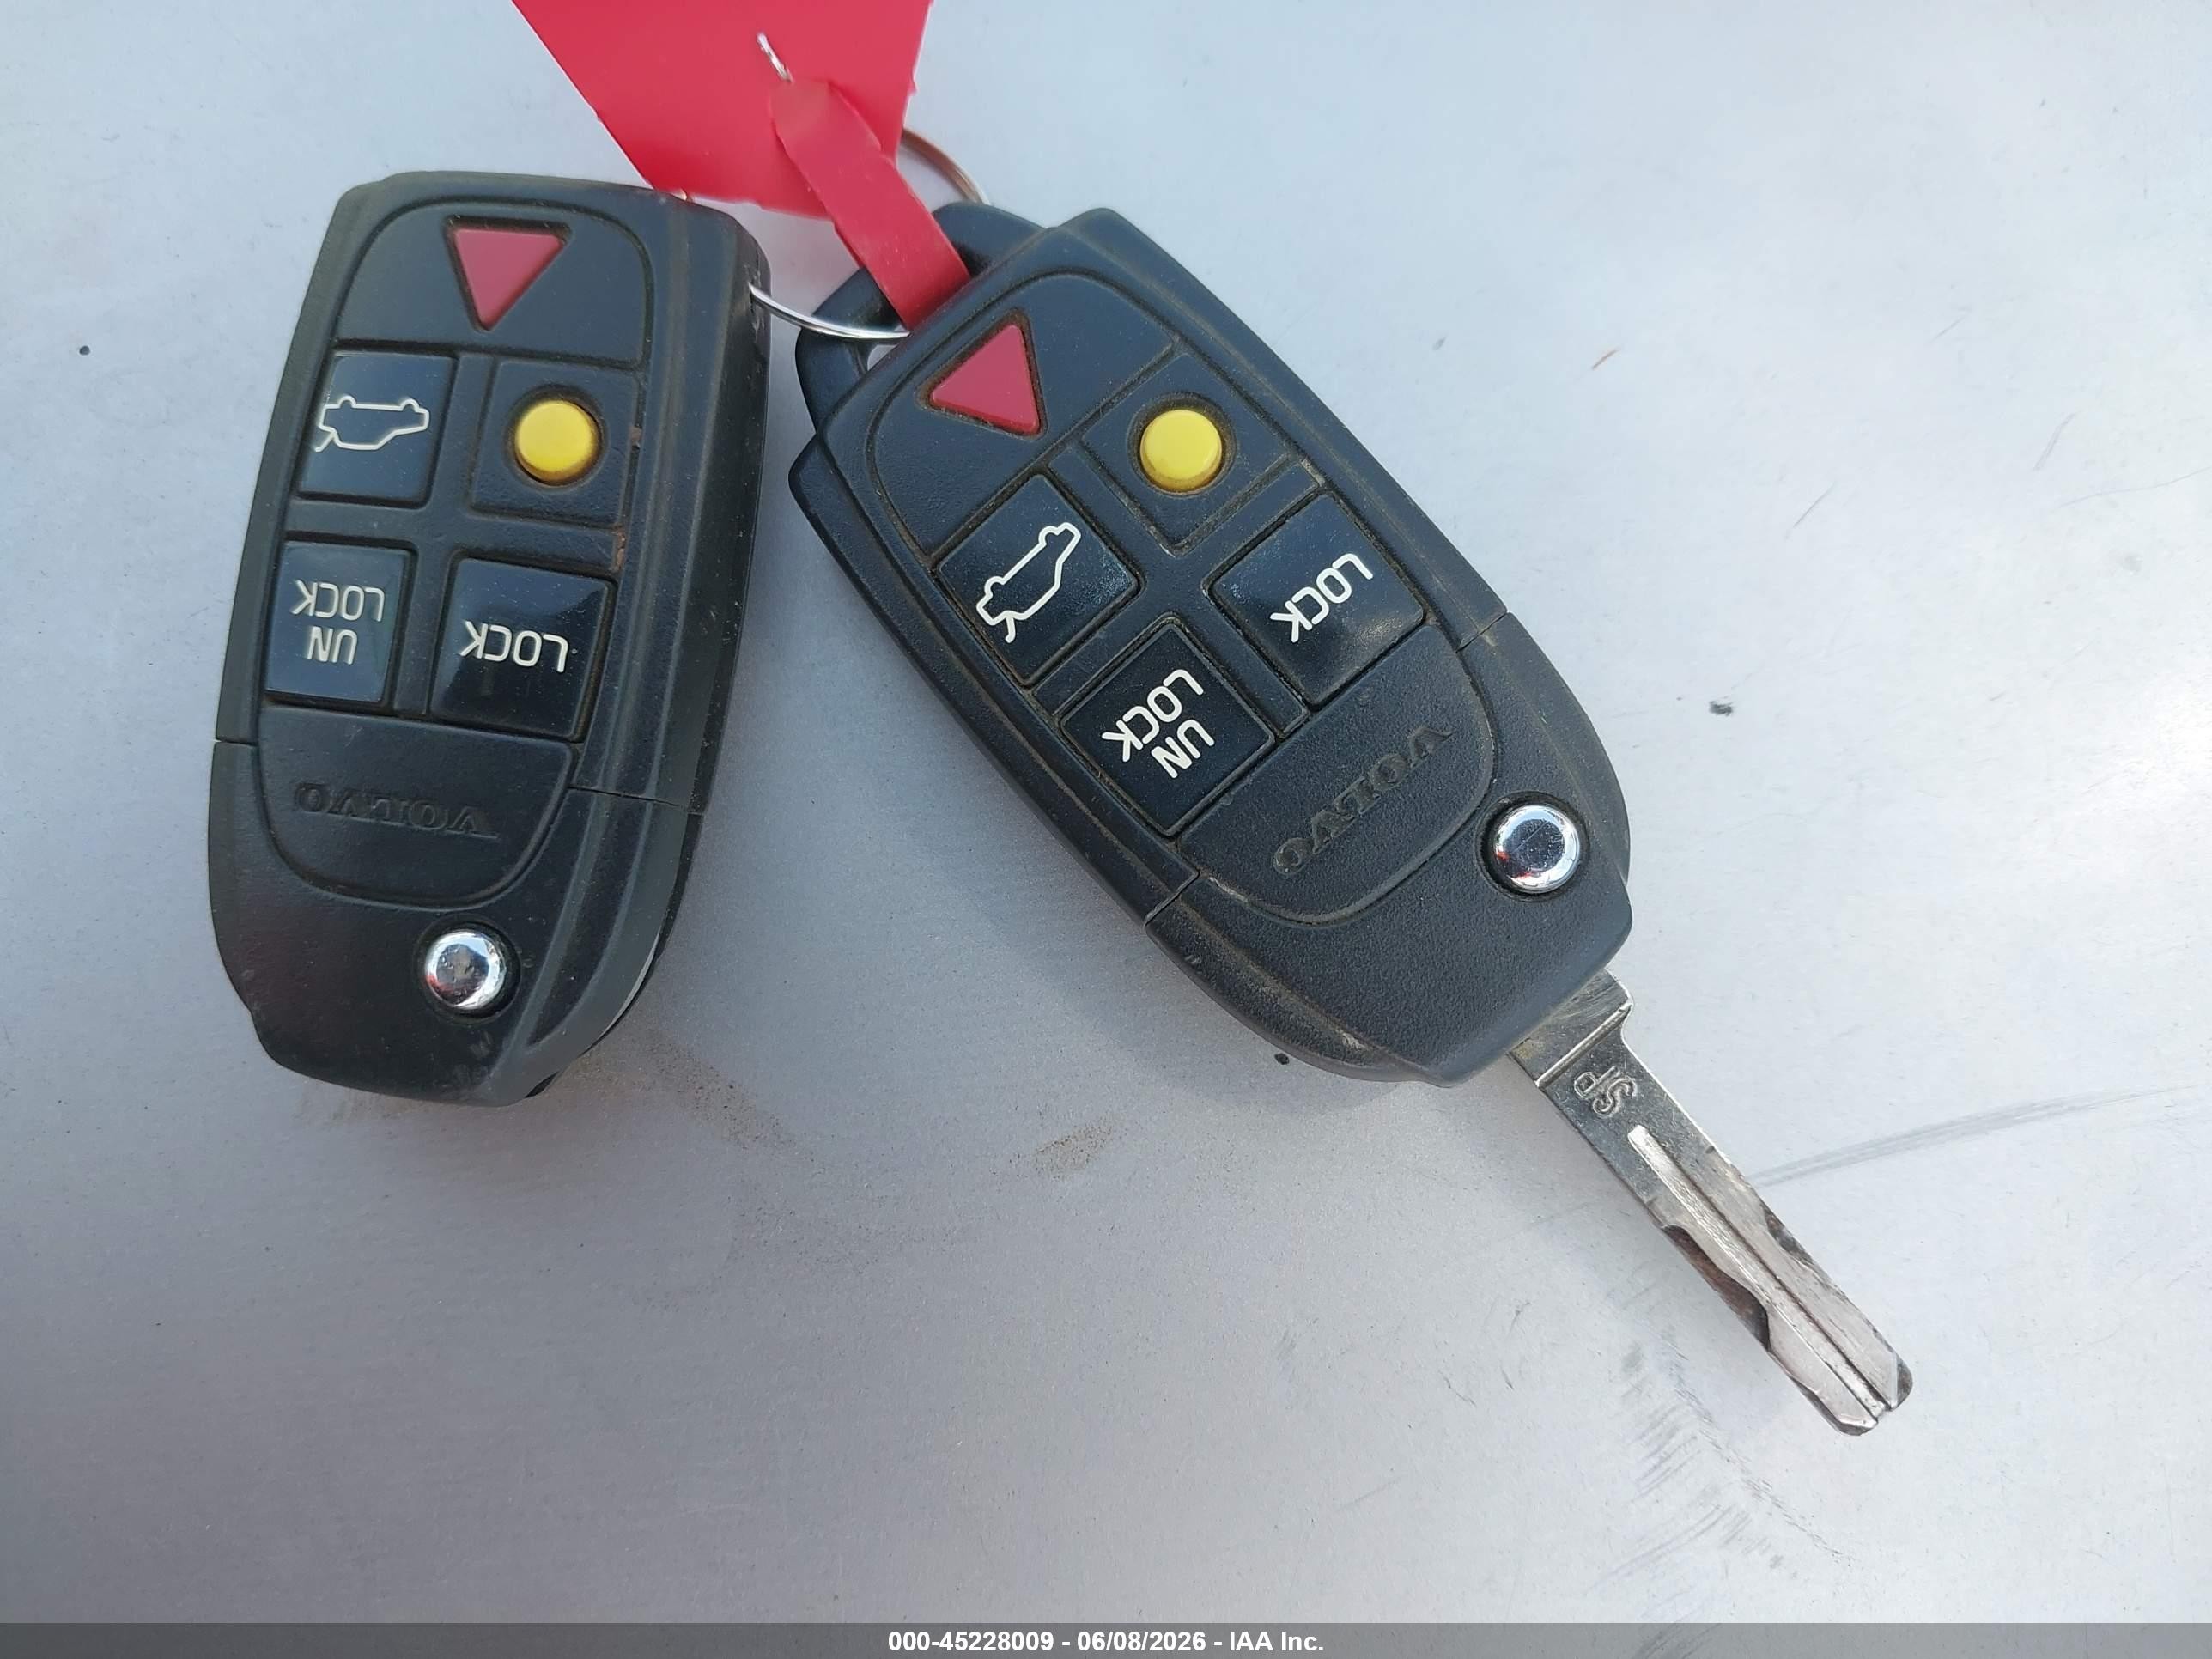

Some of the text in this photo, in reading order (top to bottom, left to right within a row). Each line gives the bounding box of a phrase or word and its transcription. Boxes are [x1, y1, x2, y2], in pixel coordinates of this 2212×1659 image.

[292, 579, 385, 622] LOCK
[1270, 554, 1374, 643] LOCK
[306, 625, 358, 665] UN
[458, 620, 569, 673] LOCK
[1101, 669, 1204, 763] LOCK
[1152, 720, 1215, 779] UN
[295, 782, 500, 840] VOLVO
[1273, 727, 1454, 875] VOLVO
